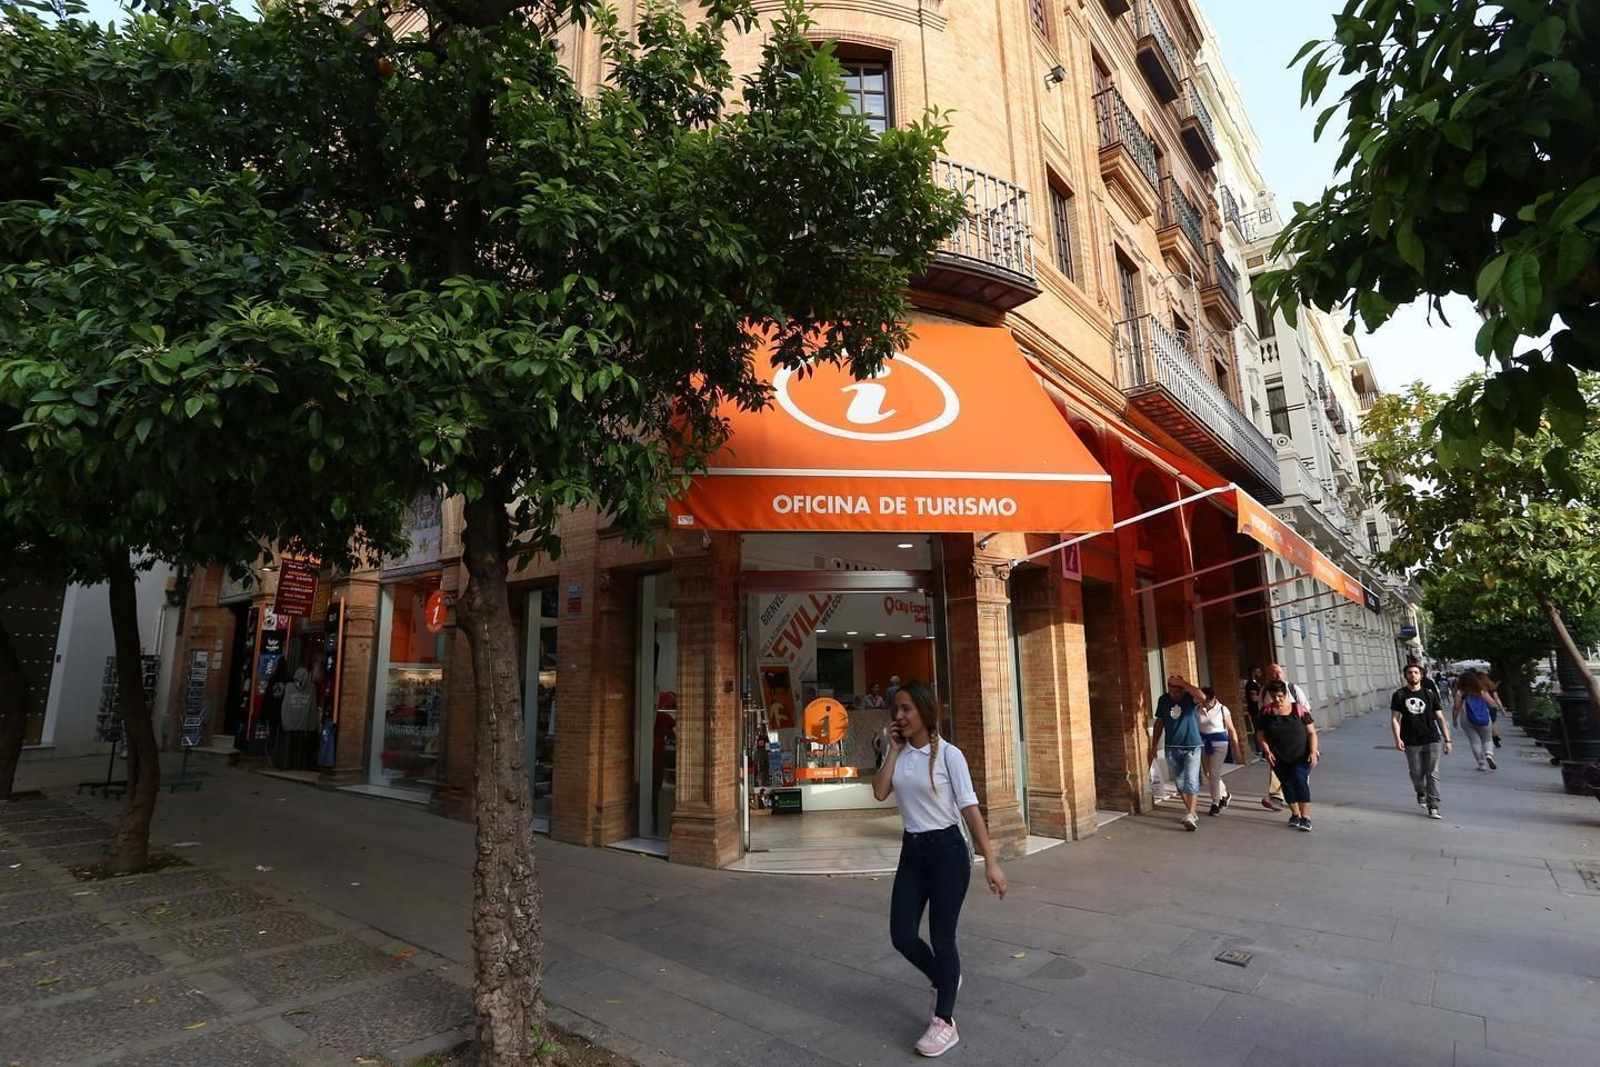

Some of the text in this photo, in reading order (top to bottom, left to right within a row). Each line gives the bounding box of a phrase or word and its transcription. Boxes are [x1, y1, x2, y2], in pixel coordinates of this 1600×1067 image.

[772, 494, 1017, 516] OFICINA DE TURISMO
[820, 594, 844, 626] WELCO
[768, 594, 834, 662] EVILL
